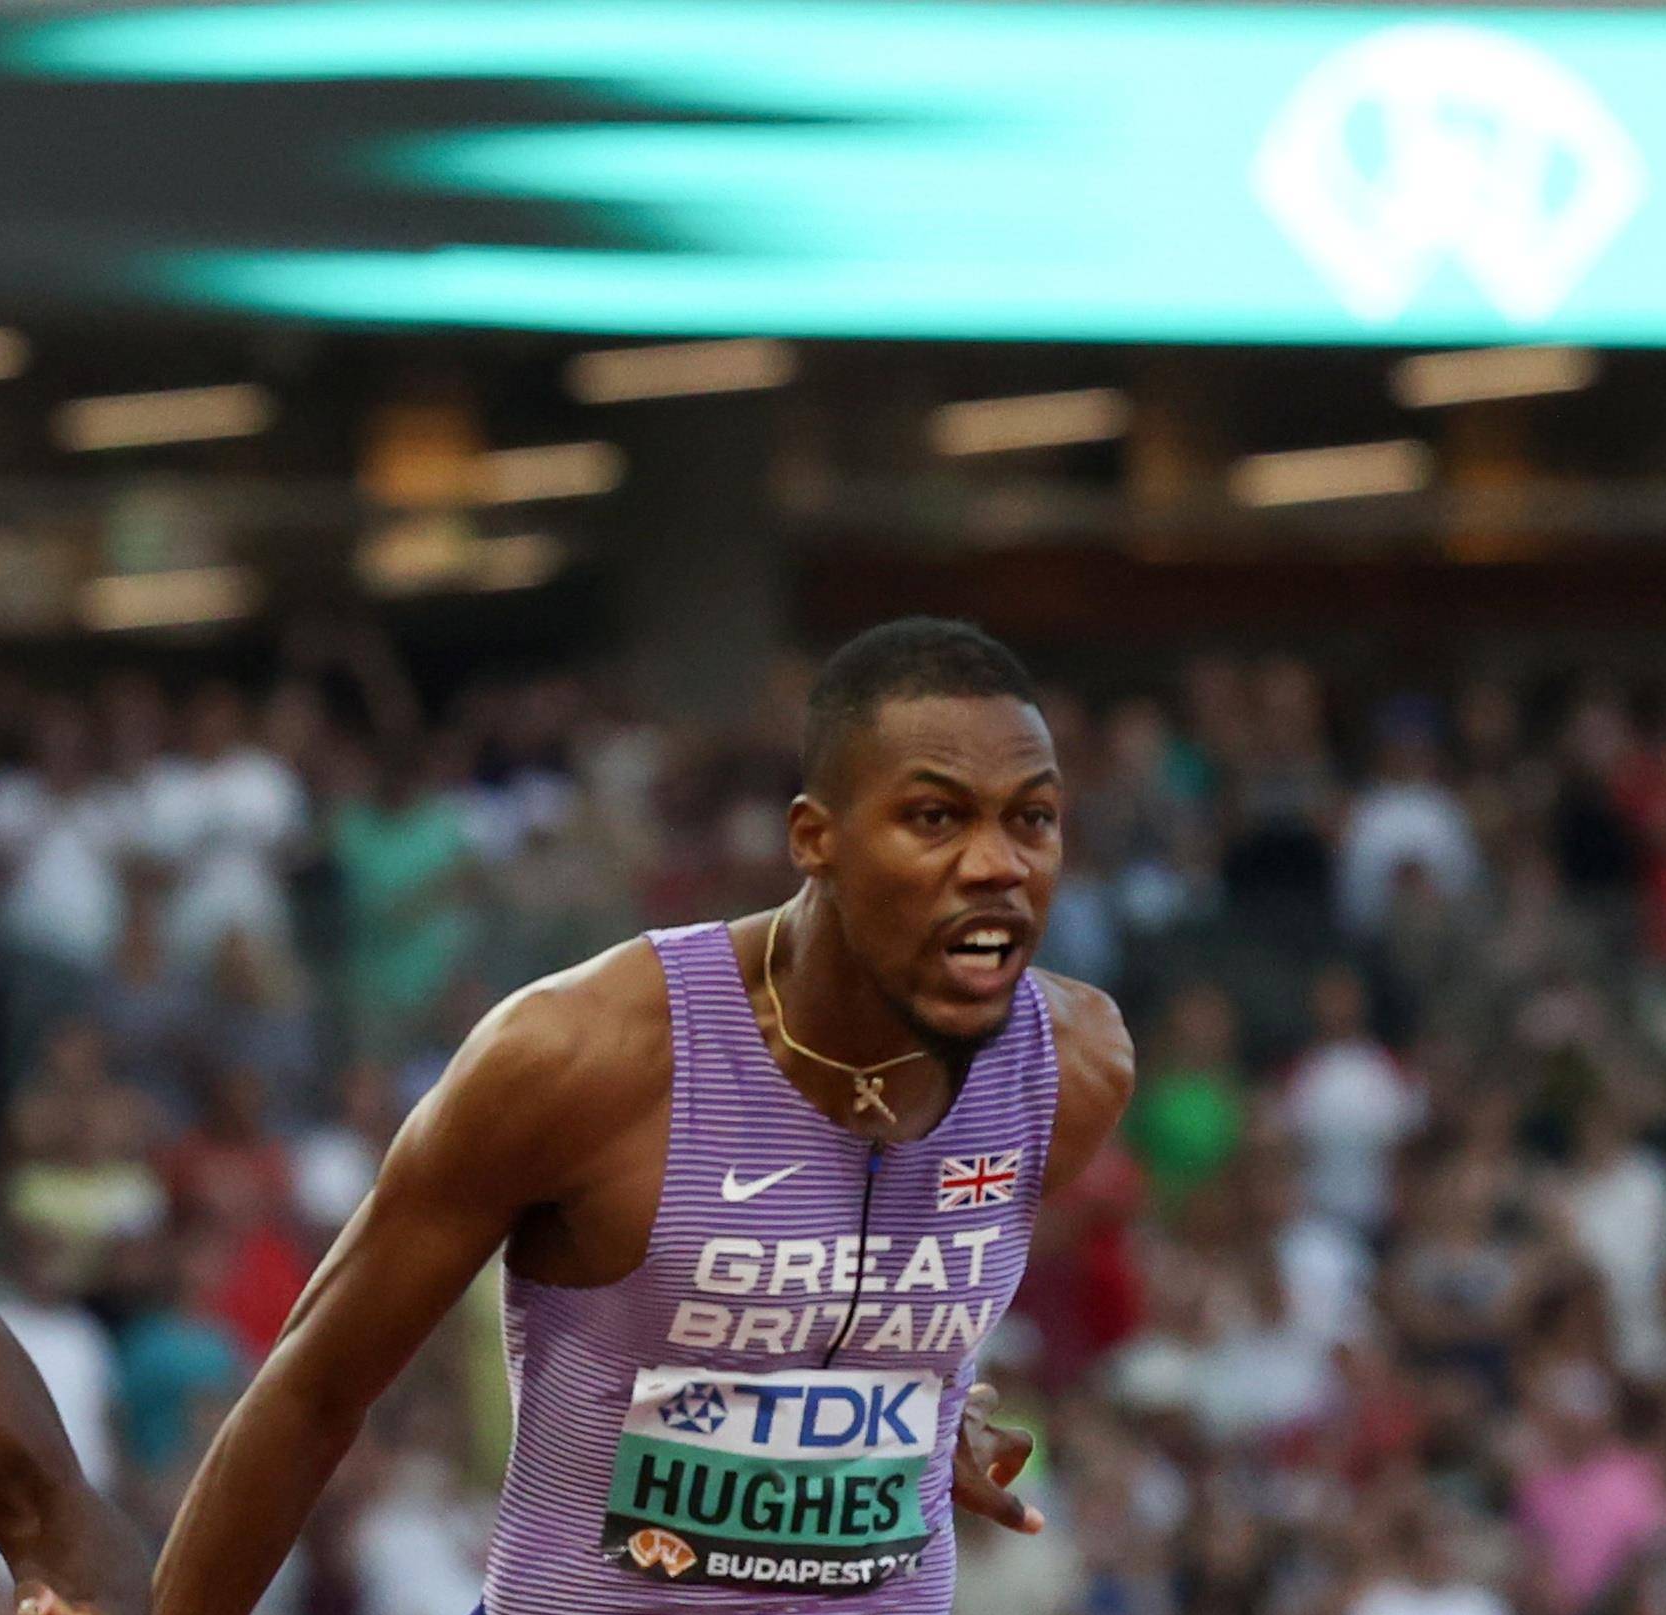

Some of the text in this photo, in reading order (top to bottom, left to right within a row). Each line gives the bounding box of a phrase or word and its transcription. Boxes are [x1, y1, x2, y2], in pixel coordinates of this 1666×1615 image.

[693, 1226, 1001, 1296] GREAT
[667, 1300, 992, 1354] BRITAIN
[734, 1381, 923, 1447] TDK
[633, 1454, 906, 1537] HUGHES
[706, 1551, 874, 1584] BUDAPEST
